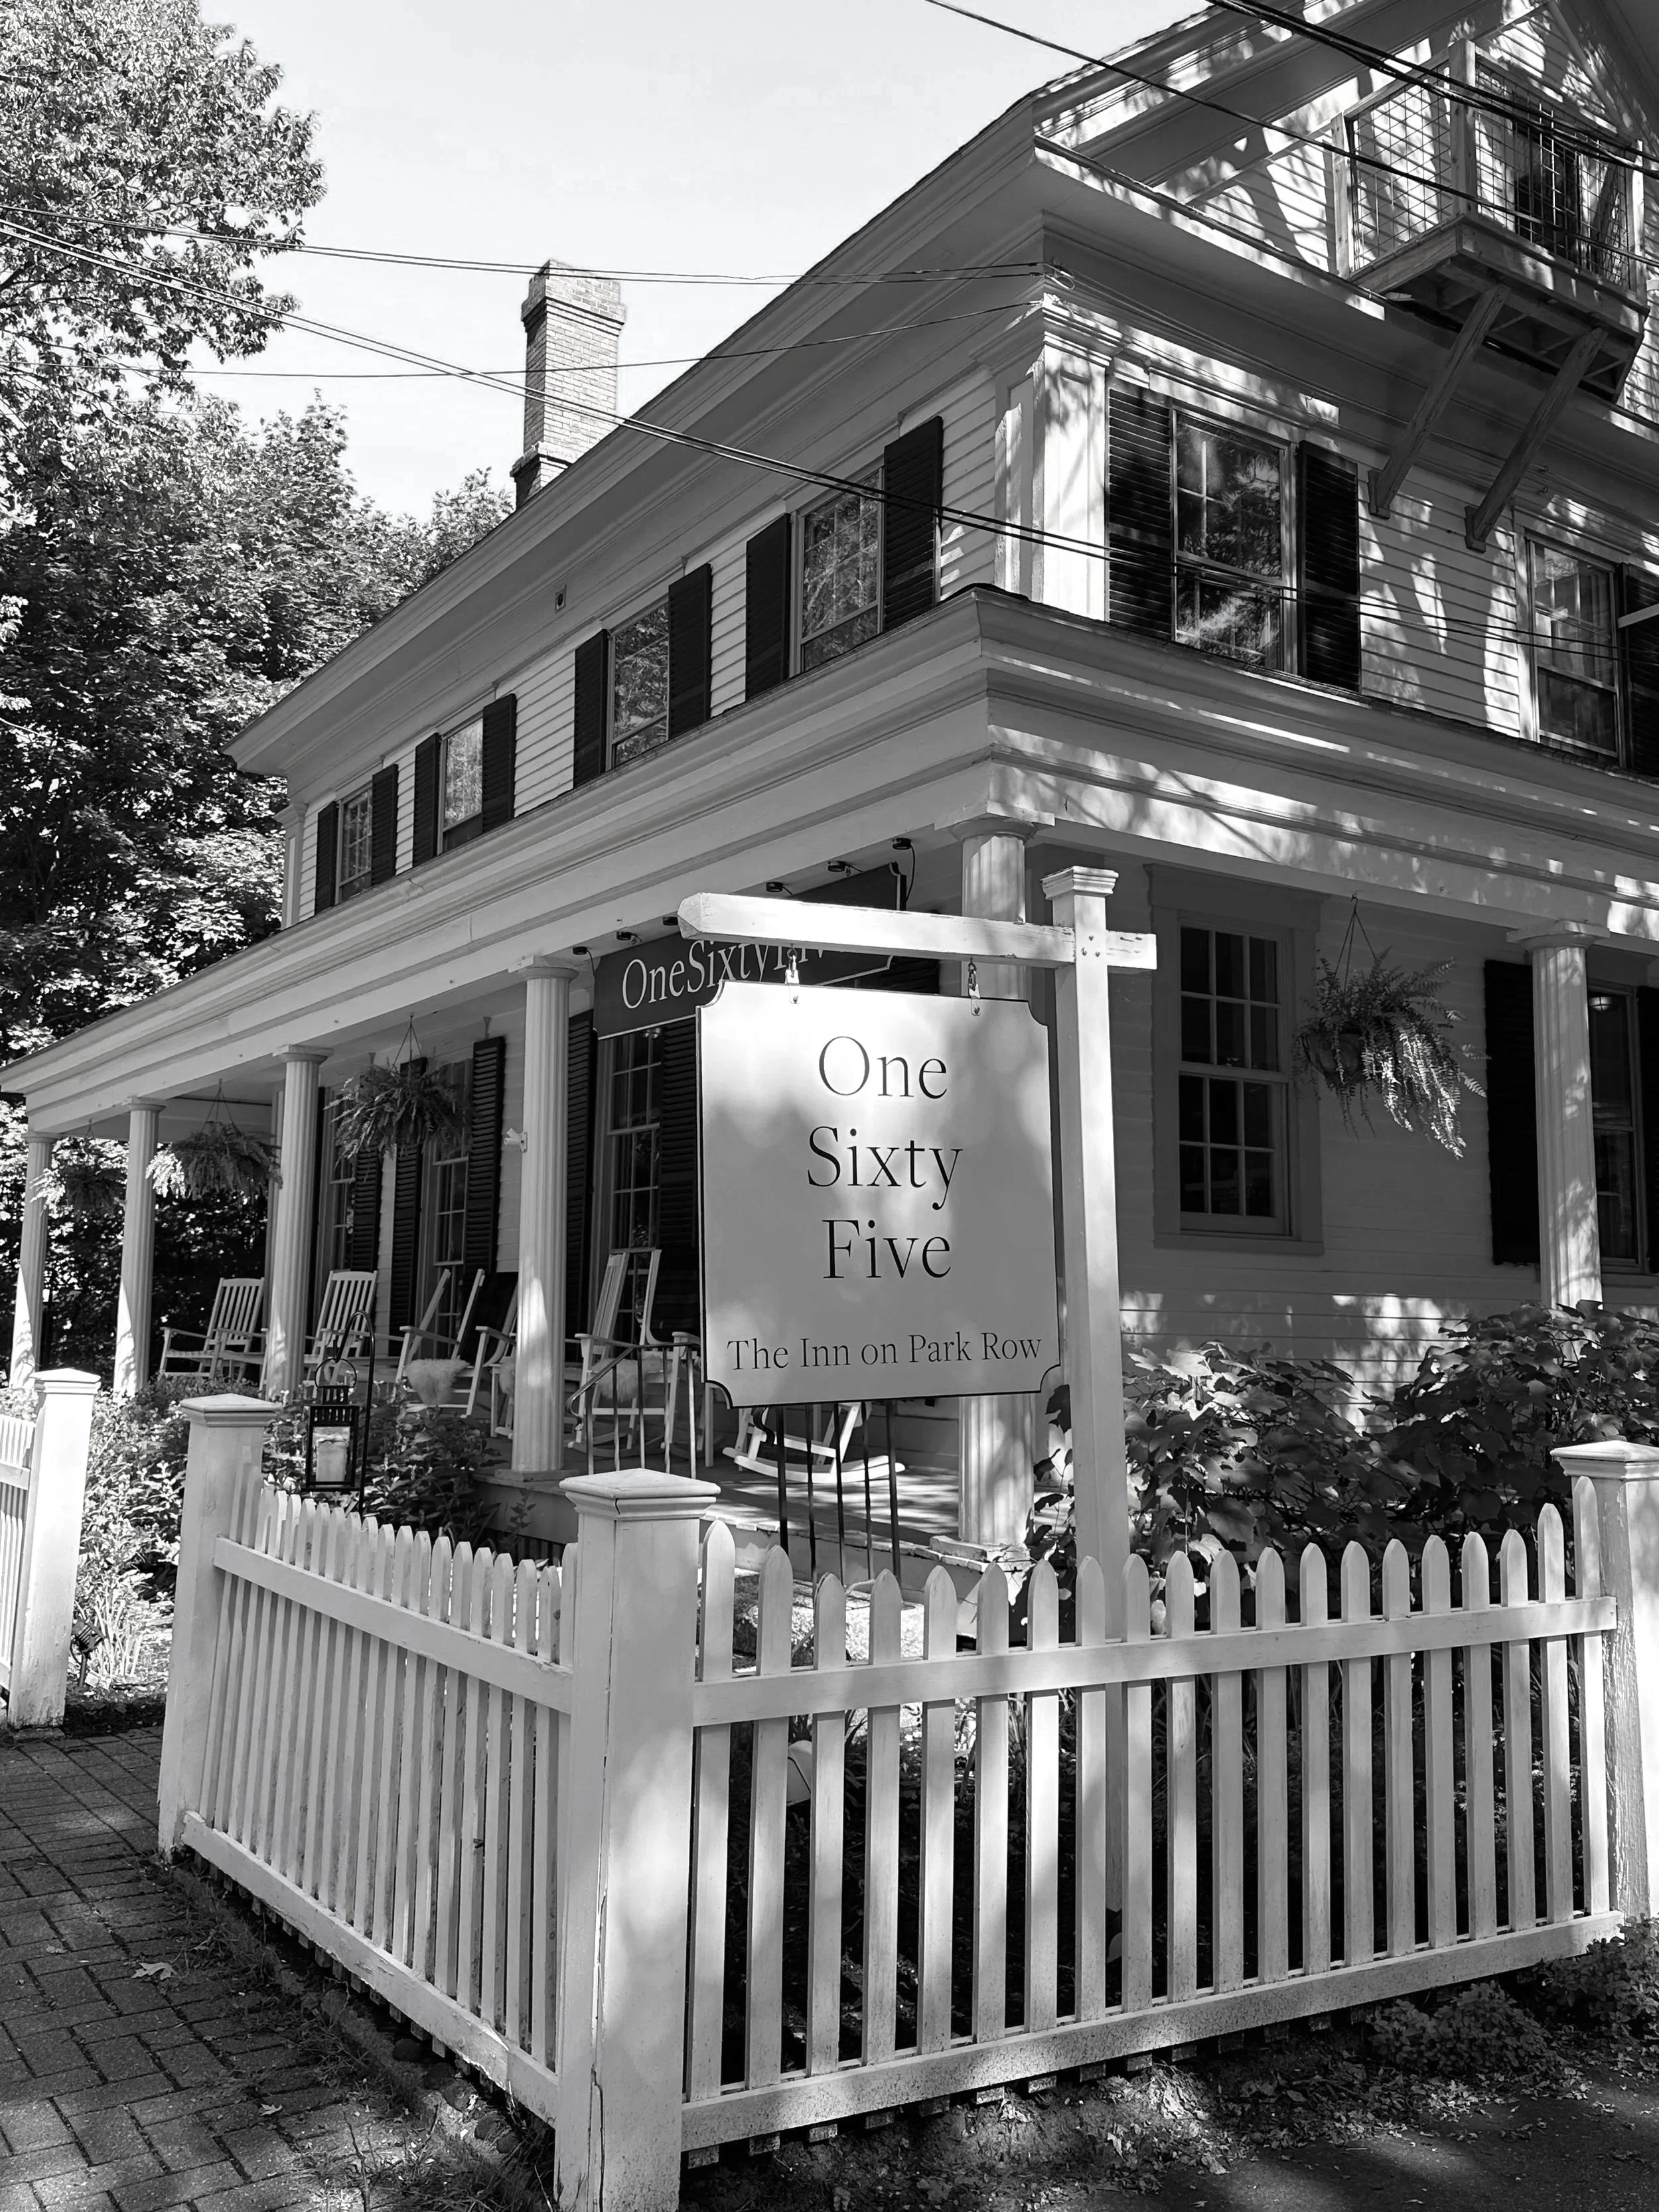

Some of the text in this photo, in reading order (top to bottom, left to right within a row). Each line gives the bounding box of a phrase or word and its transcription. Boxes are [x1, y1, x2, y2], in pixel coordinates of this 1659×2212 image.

[818, 1035, 948, 1100] One
[807, 1126, 964, 1211] Sixty
[821, 1219, 952, 1279] Five
[726, 1331, 1043, 1370] The Inn on Park Row
